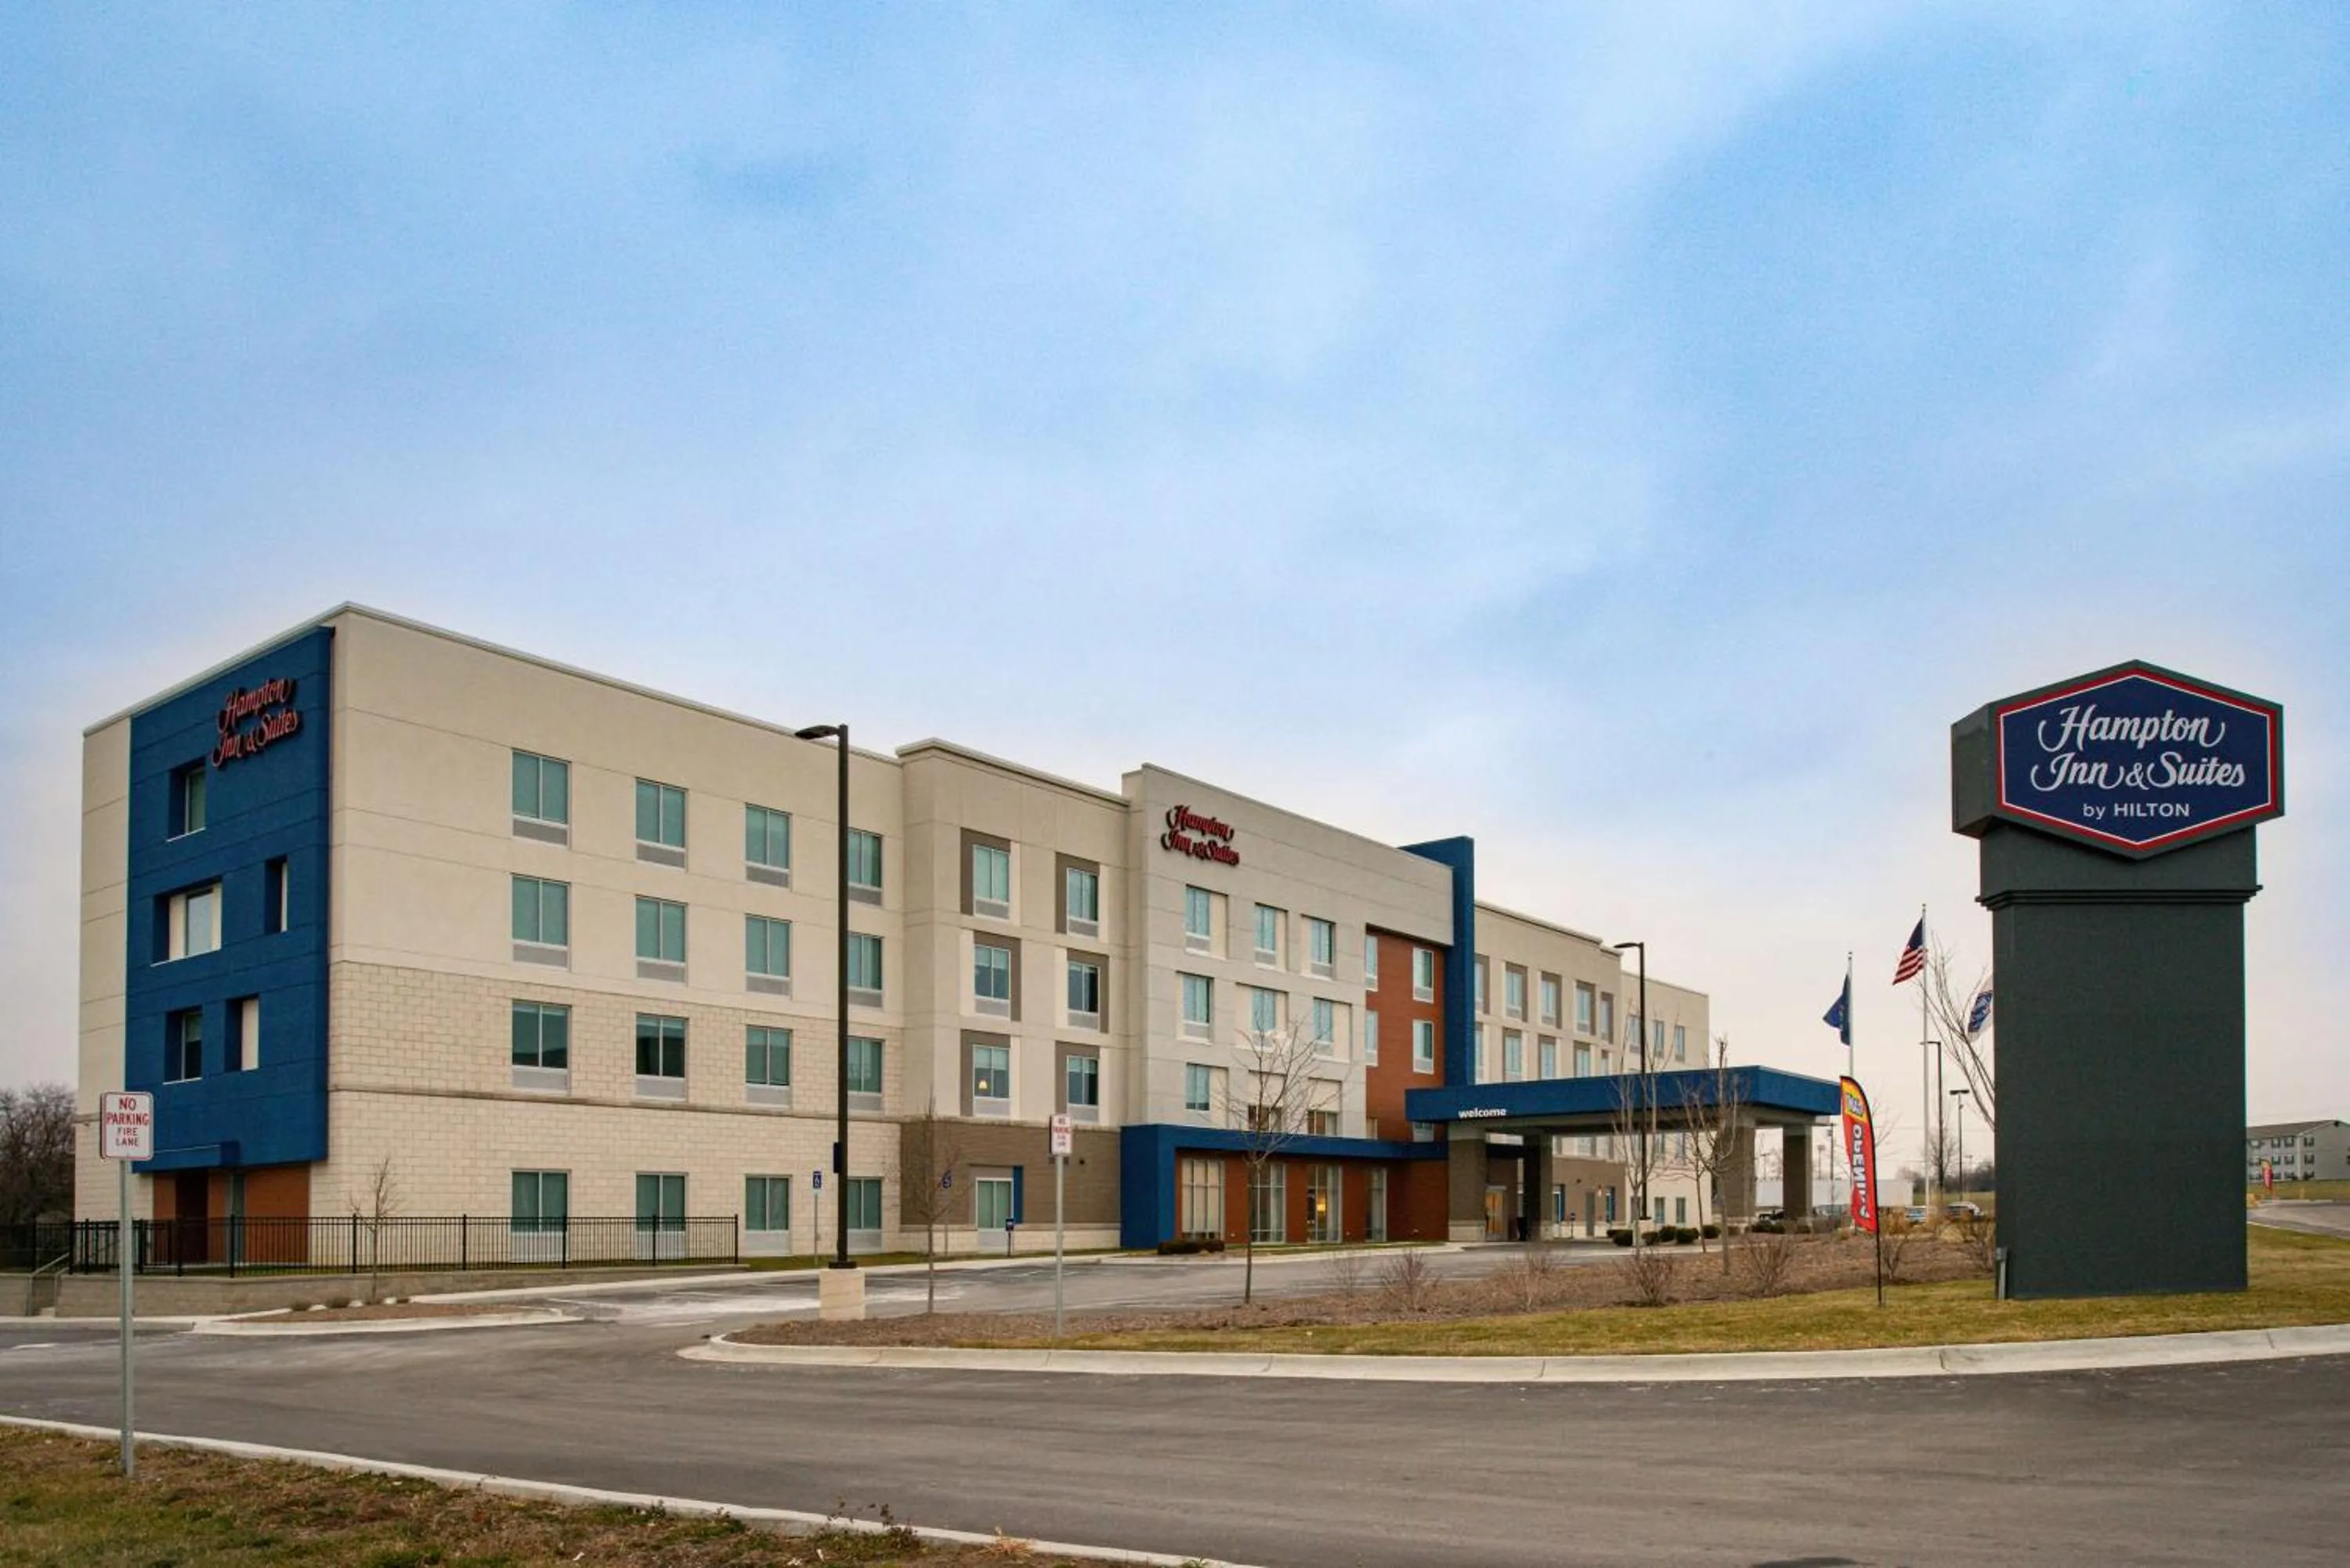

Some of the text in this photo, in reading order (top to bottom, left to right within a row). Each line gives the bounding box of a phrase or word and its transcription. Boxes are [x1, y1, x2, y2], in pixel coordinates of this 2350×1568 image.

[216, 677, 292, 734] Hampton
[212, 707, 298, 767] Inn & Suites
[2038, 704, 2225, 752] Hampton
[2030, 751, 2246, 791] Inn & Suites
[1166, 805, 1235, 842] Hampton
[2083, 803, 2189, 819] by HILTON
[1160, 829, 1197, 857] Inn
[1206, 840, 1239, 866] Suites
[119, 1097, 136, 1111] NO
[1458, 1107, 1506, 1118] welcome
[106, 1113, 150, 1125] PARKING
[118, 1127, 138, 1136] FIRE
[115, 1137, 138, 1147] LANE
